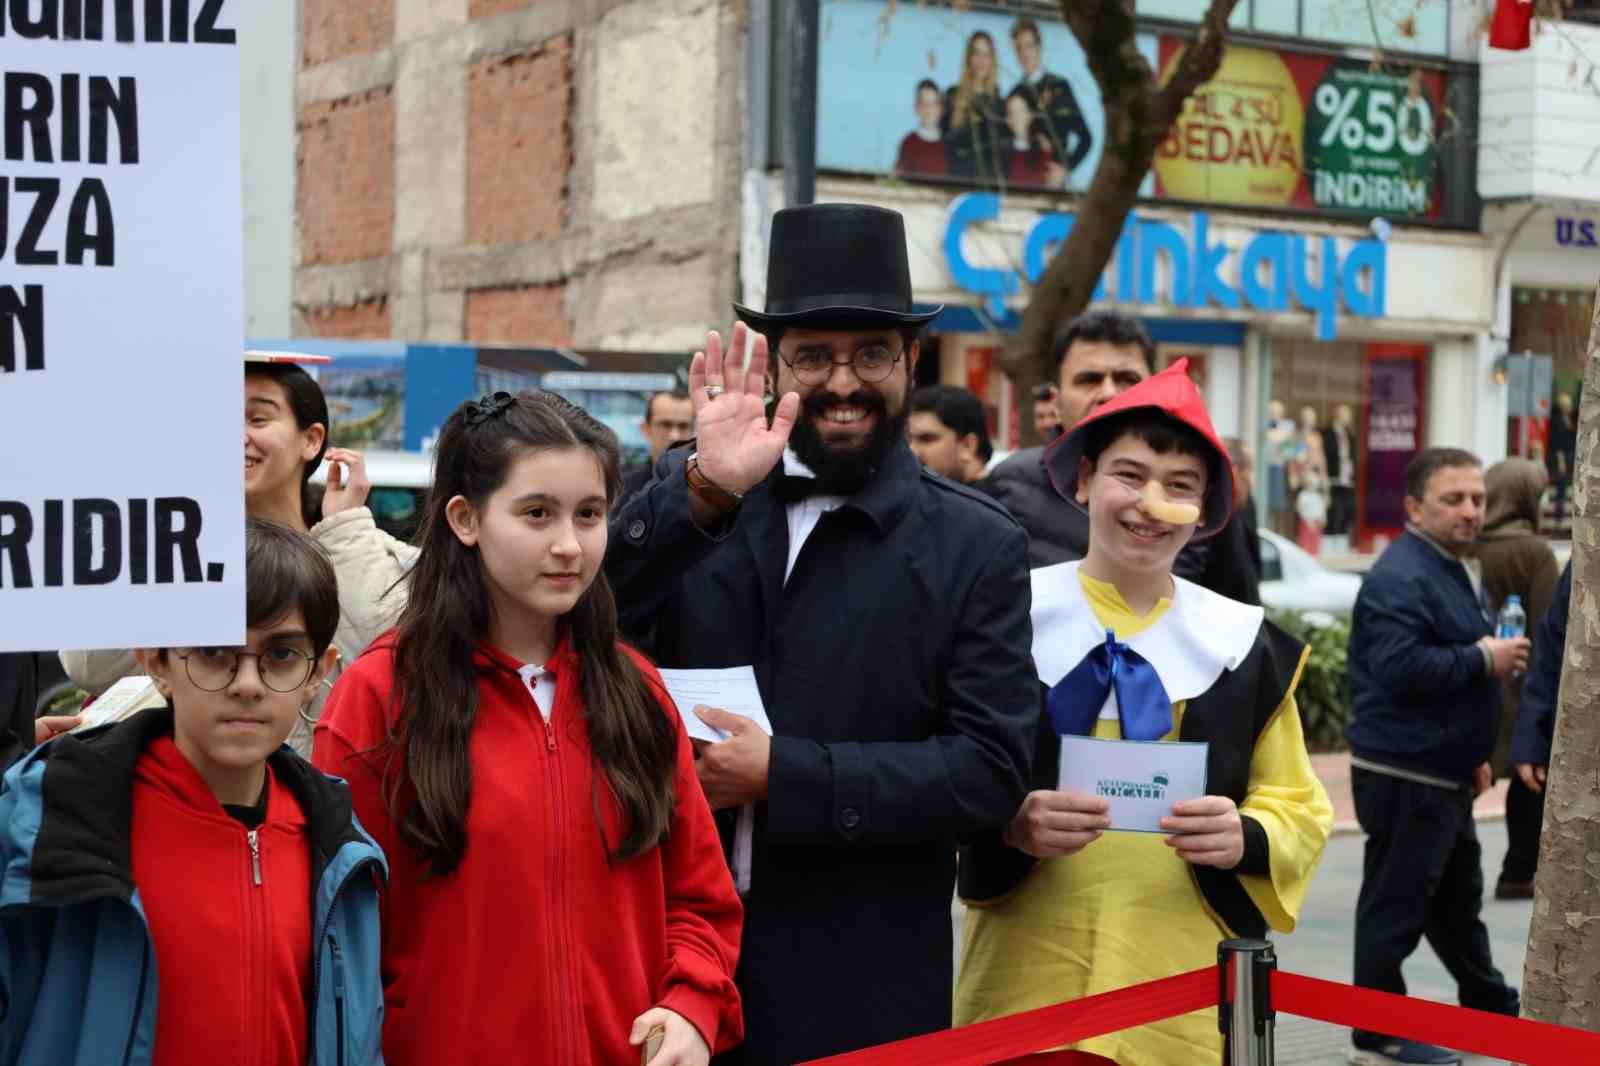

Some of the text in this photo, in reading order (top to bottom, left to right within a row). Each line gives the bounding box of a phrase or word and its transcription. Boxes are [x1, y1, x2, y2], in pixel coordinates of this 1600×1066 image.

[1160, 122, 1299, 168] BEDAVA
[1315, 82, 1434, 156] %50
[0, 175, 115, 267] ZA
